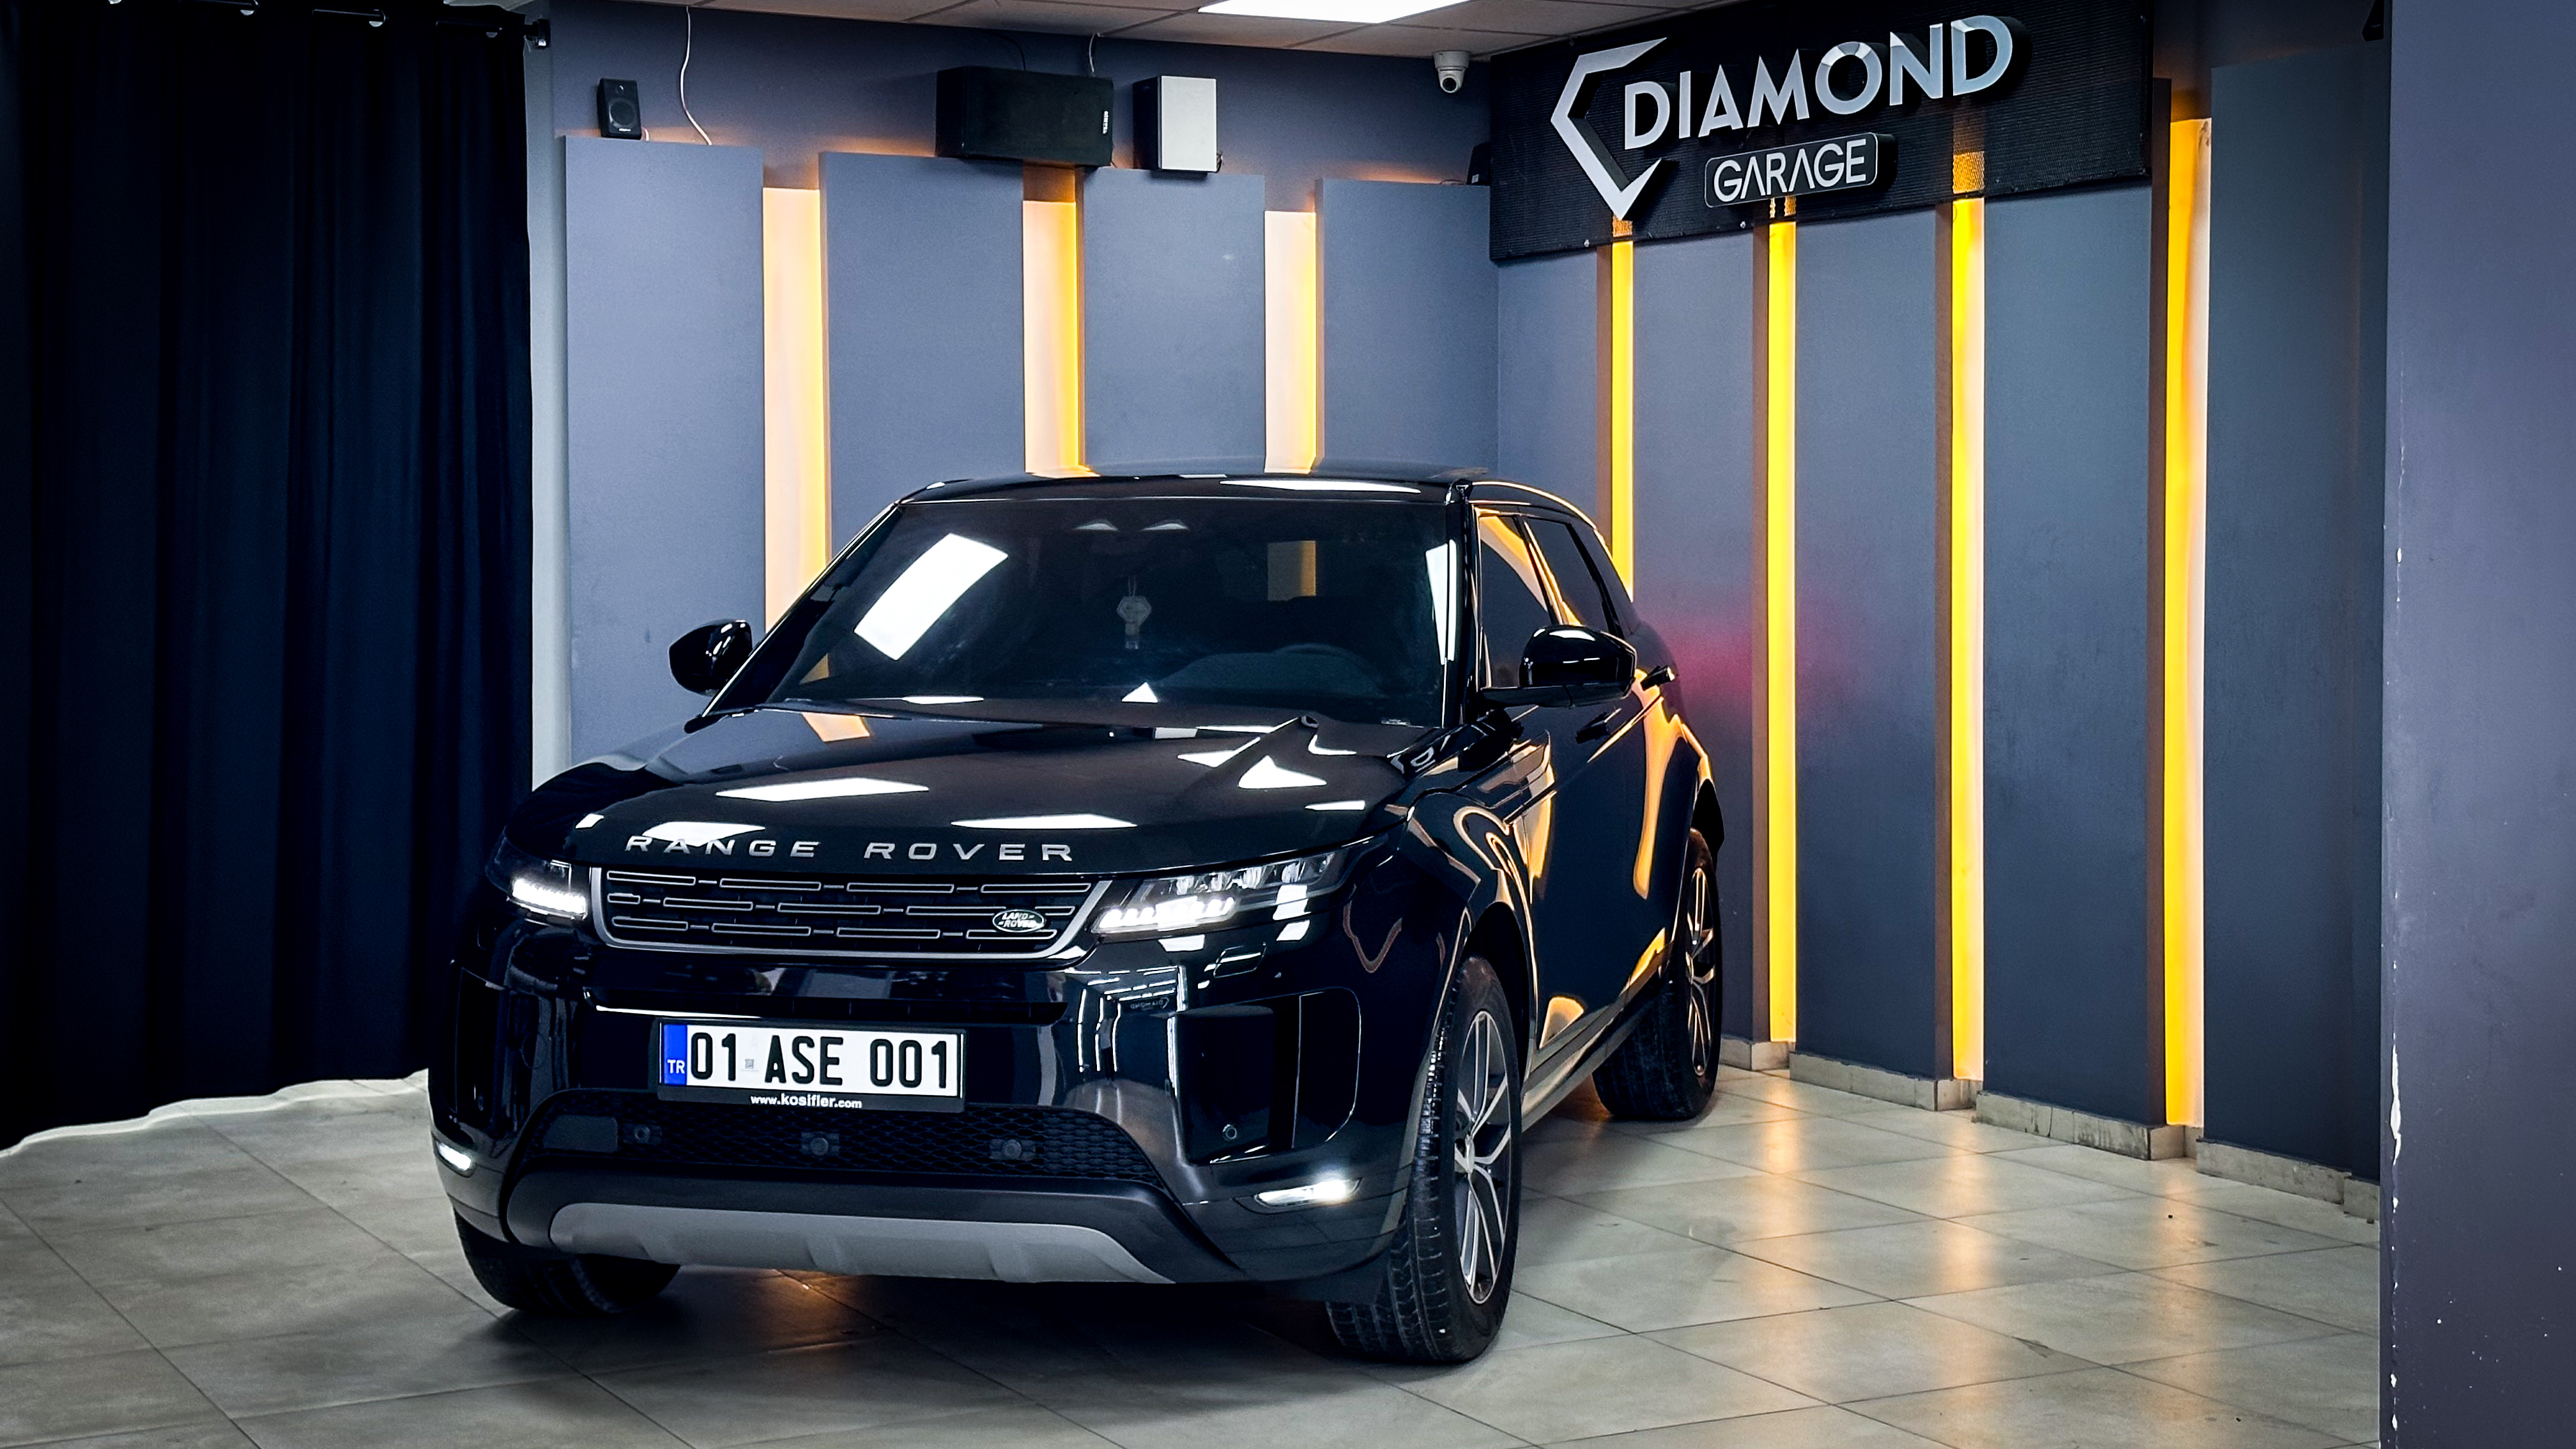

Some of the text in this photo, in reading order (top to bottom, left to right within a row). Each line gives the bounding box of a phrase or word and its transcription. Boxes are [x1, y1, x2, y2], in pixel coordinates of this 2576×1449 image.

[1625, 15, 2013, 150] DIAMOND
[1714, 139, 1866, 202] GARAGE
[625, 836, 1073, 861] RANGE ROVER
[667, 1059, 685, 1074] TR
[691, 1032, 947, 1089] 01 ASE 001
